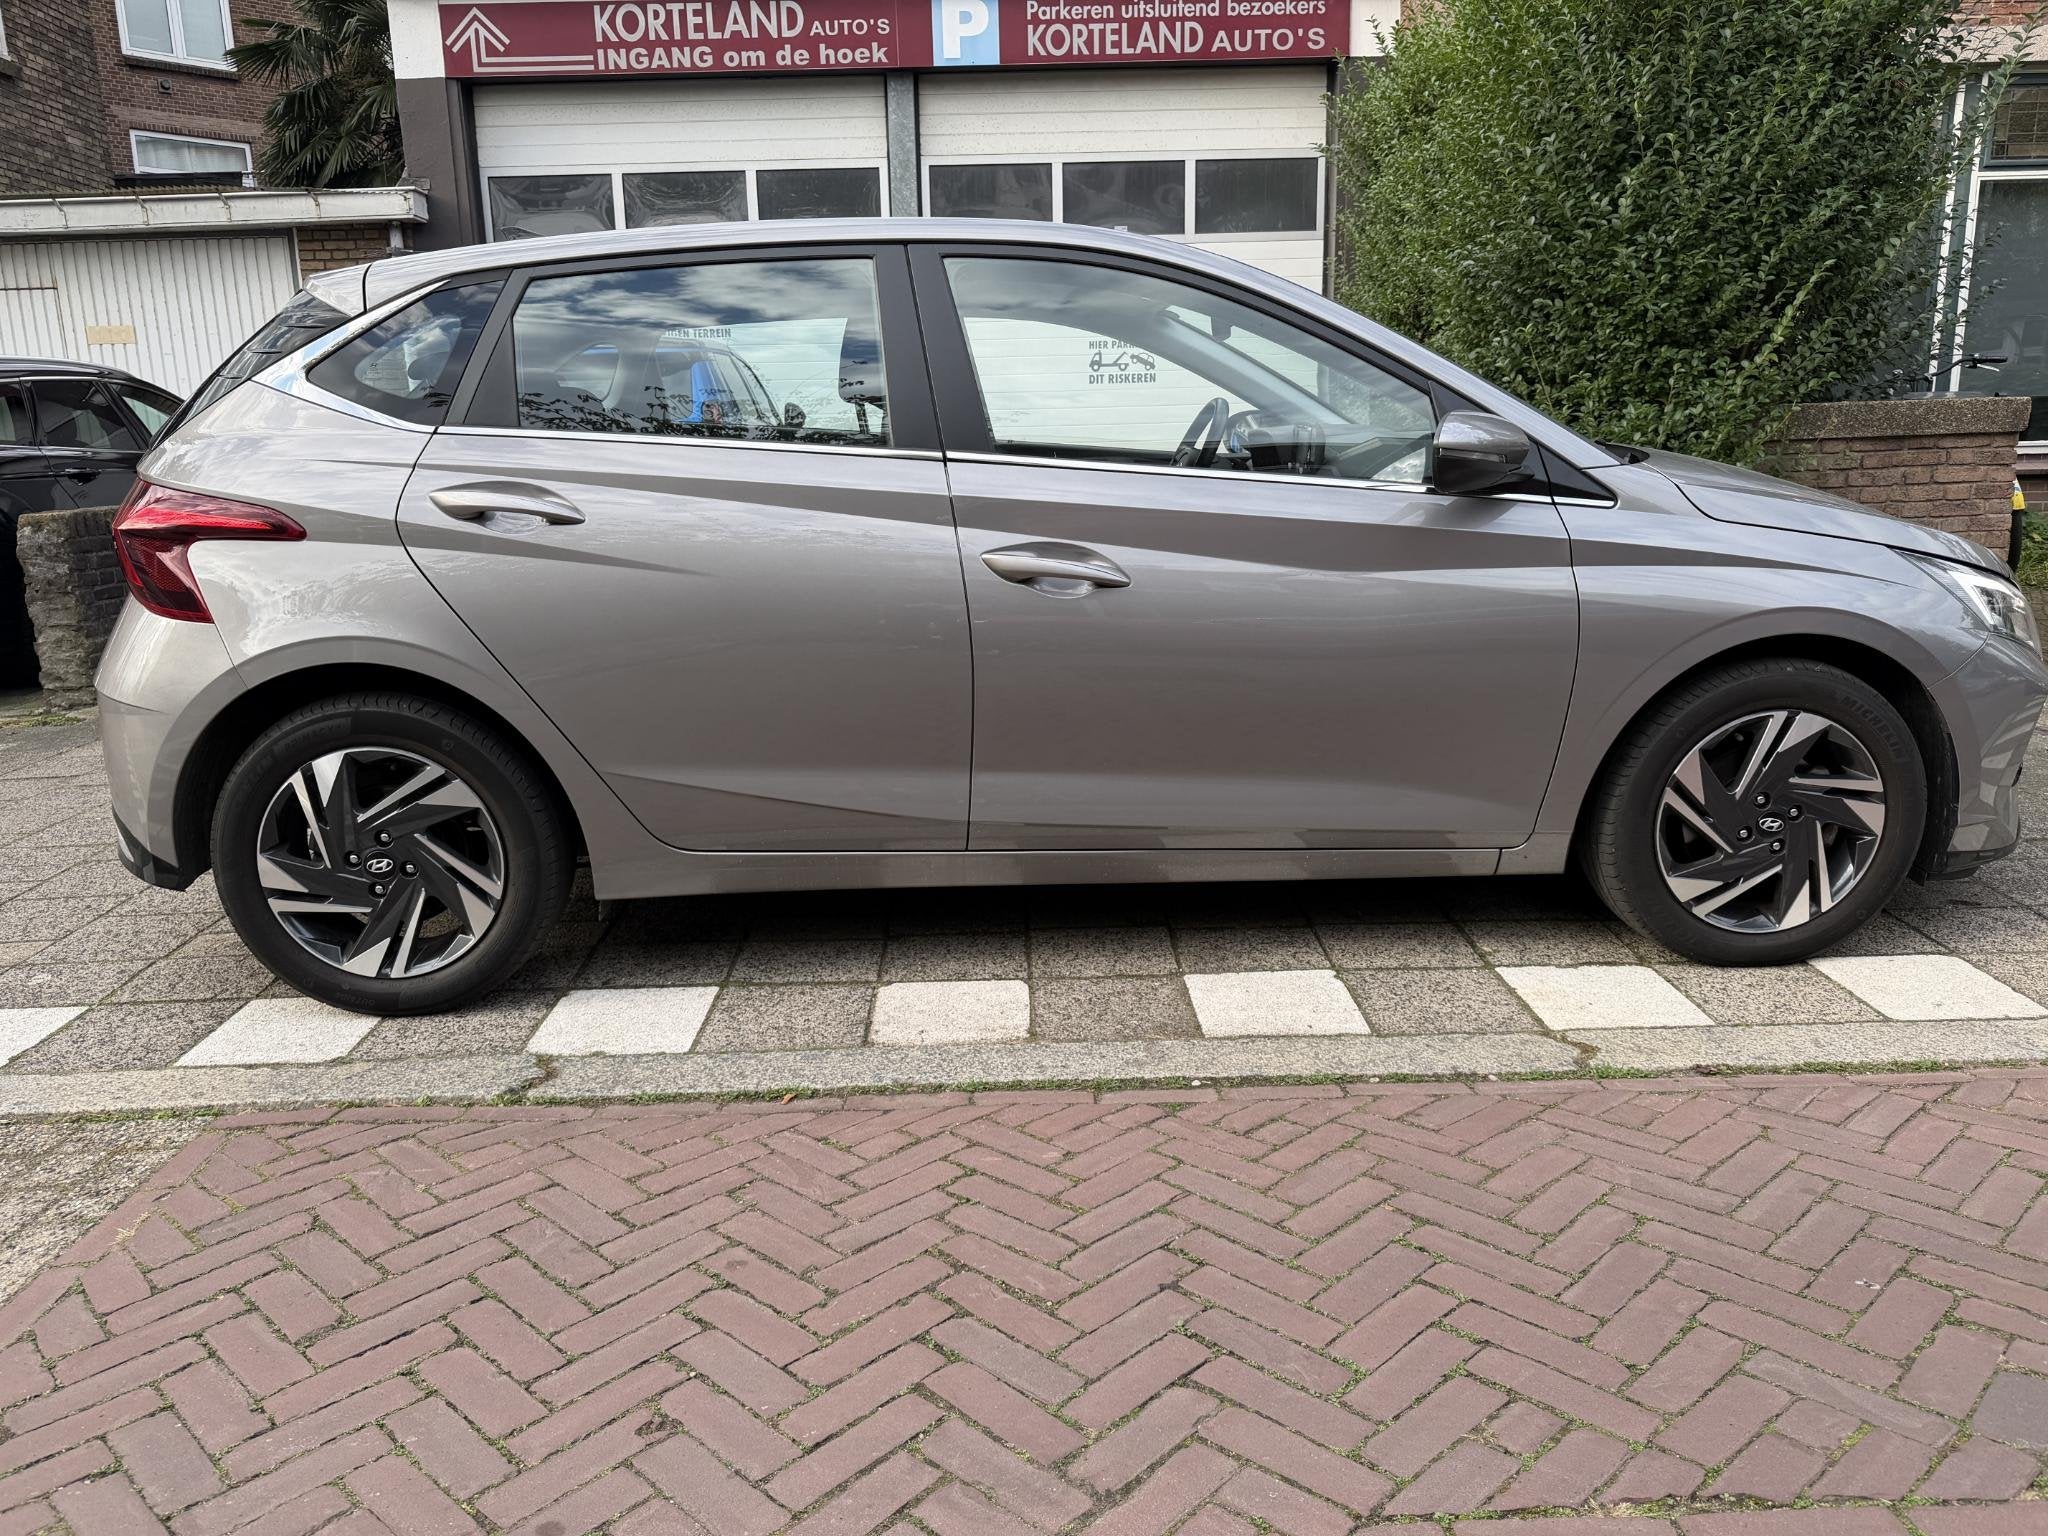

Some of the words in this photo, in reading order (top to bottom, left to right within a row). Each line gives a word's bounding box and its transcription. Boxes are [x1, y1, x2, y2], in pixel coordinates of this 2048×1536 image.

[594, 0, 804, 42] KORTELAND
[810, 18, 890, 37] AUTO'S
[1026, 0, 1114, 20] Parkeren
[1121, 0, 1217, 18] uitsluitend
[1227, 0, 1326, 16] bezoekers
[942, 0, 989, 58] P
[1027, 21, 1204, 57] KORTELAND
[1211, 27, 1326, 52] AUTO'S
[598, 45, 714, 70] INGANG
[723, 52, 766, 67] om
[775, 44, 810, 67] de
[819, 42, 889, 65] hoek
[693, 328, 732, 338] TERREIN
[1089, 341, 1108, 350] HIER
[1089, 374, 1104, 384] DIT
[1108, 373, 1156, 384] RISKEREN
